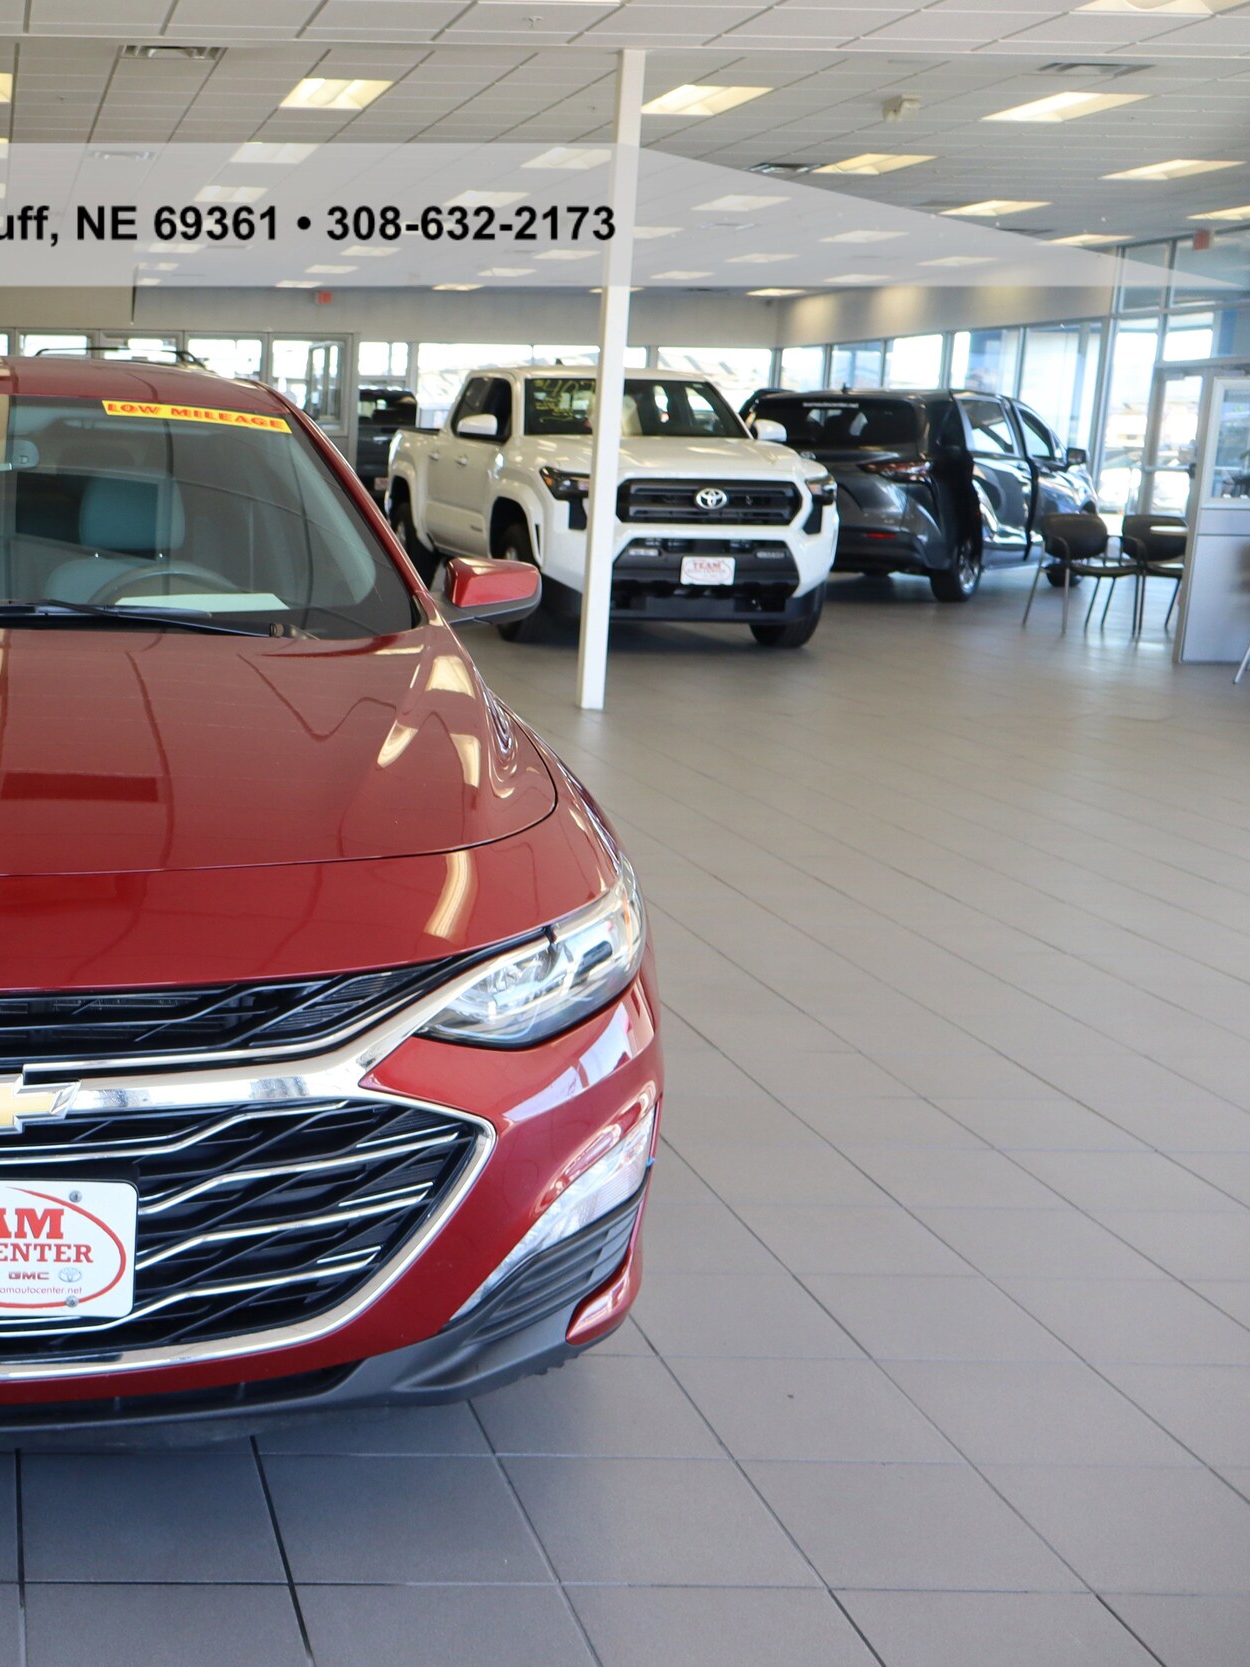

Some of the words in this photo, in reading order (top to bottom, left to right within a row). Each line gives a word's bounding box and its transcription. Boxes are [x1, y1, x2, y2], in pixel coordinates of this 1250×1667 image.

[107, 403, 159, 414] LOW
[170, 407, 285, 430] MILEAGE
[7, 1271, 50, 1281] GMC
